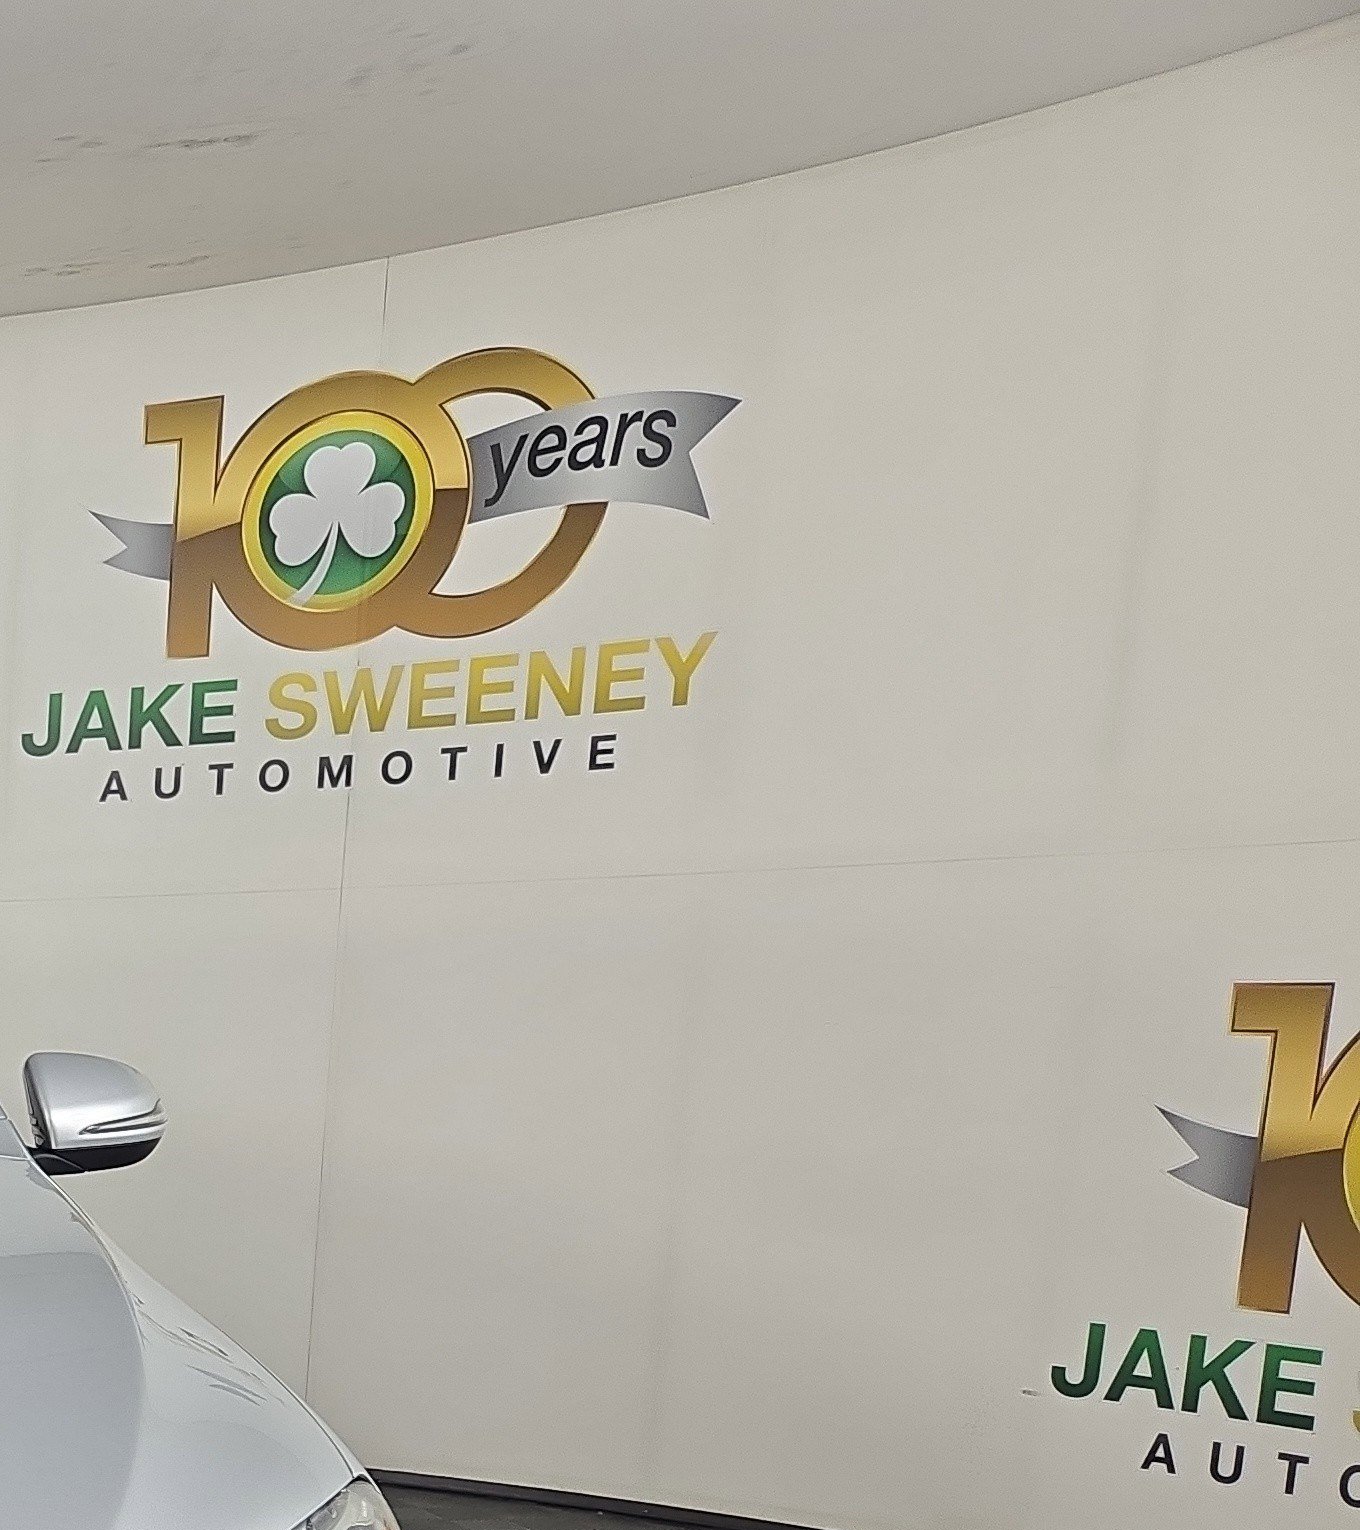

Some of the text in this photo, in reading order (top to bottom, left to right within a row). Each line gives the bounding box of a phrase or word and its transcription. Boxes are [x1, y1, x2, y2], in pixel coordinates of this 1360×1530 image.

[145, 347, 608, 658] 100
[484, 409, 676, 508] years
[21, 631, 719, 757] JAKE SWEENEY
[99, 735, 617, 802] AUTOMOTIVE
[1051, 1322, 1323, 1431] JAKE
